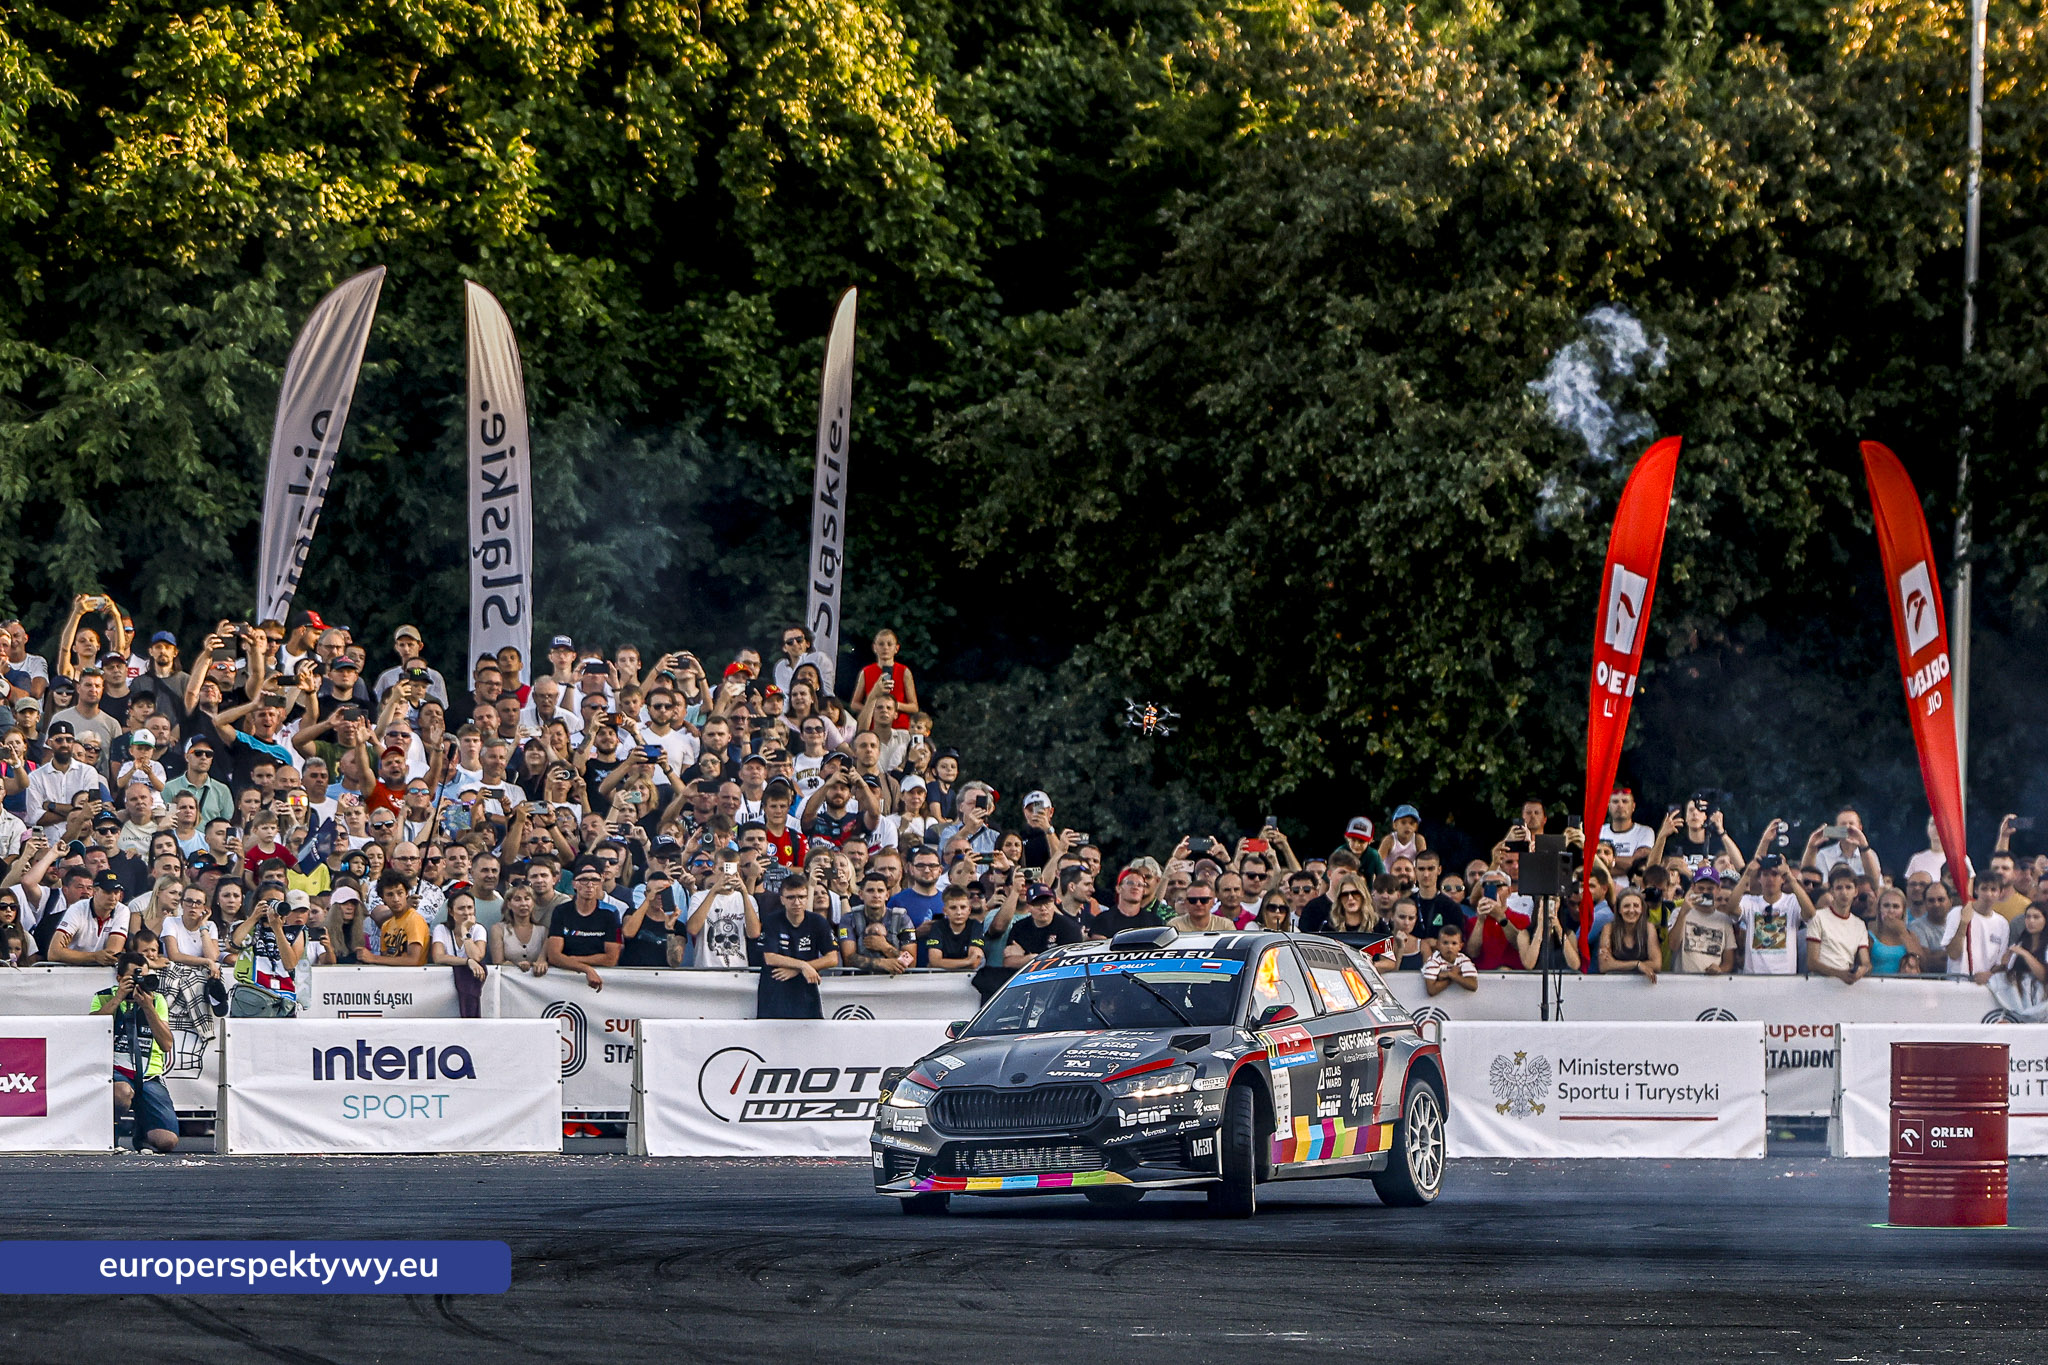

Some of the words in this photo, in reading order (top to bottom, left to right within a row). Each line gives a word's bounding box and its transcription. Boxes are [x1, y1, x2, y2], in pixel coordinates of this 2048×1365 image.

[1028, 957, 1060, 972] 17
[1058, 950, 1215, 967] KATOWICE.EU
[1117, 962, 1147, 970] RALLY
[323, 993, 371, 1005] STADION
[374, 990, 413, 1009] ŚLĄSKI
[1339, 1031, 1374, 1052] GKFORGE
[1765, 1024, 1834, 1043] upera
[312, 1039, 477, 1081] interia
[1559, 1058, 1679, 1076] Ministerstwo
[1765, 1049, 1834, 1069] TADION
[1325, 1066, 1341, 1077] ATLAS
[1326, 1077, 1342, 1089] WARD
[1358, 1092, 1374, 1108] KSSE
[1558, 1083, 1619, 1103] Sportu
[1625, 1083, 1629, 1100] i
[1636, 1083, 1719, 1104] Turystyki
[343, 1094, 450, 1119] SPORT
[744, 1101, 878, 1119] WIZJ
[1930, 1127, 1974, 1138] ORLEN
[1930, 1140, 1948, 1148] OIL
